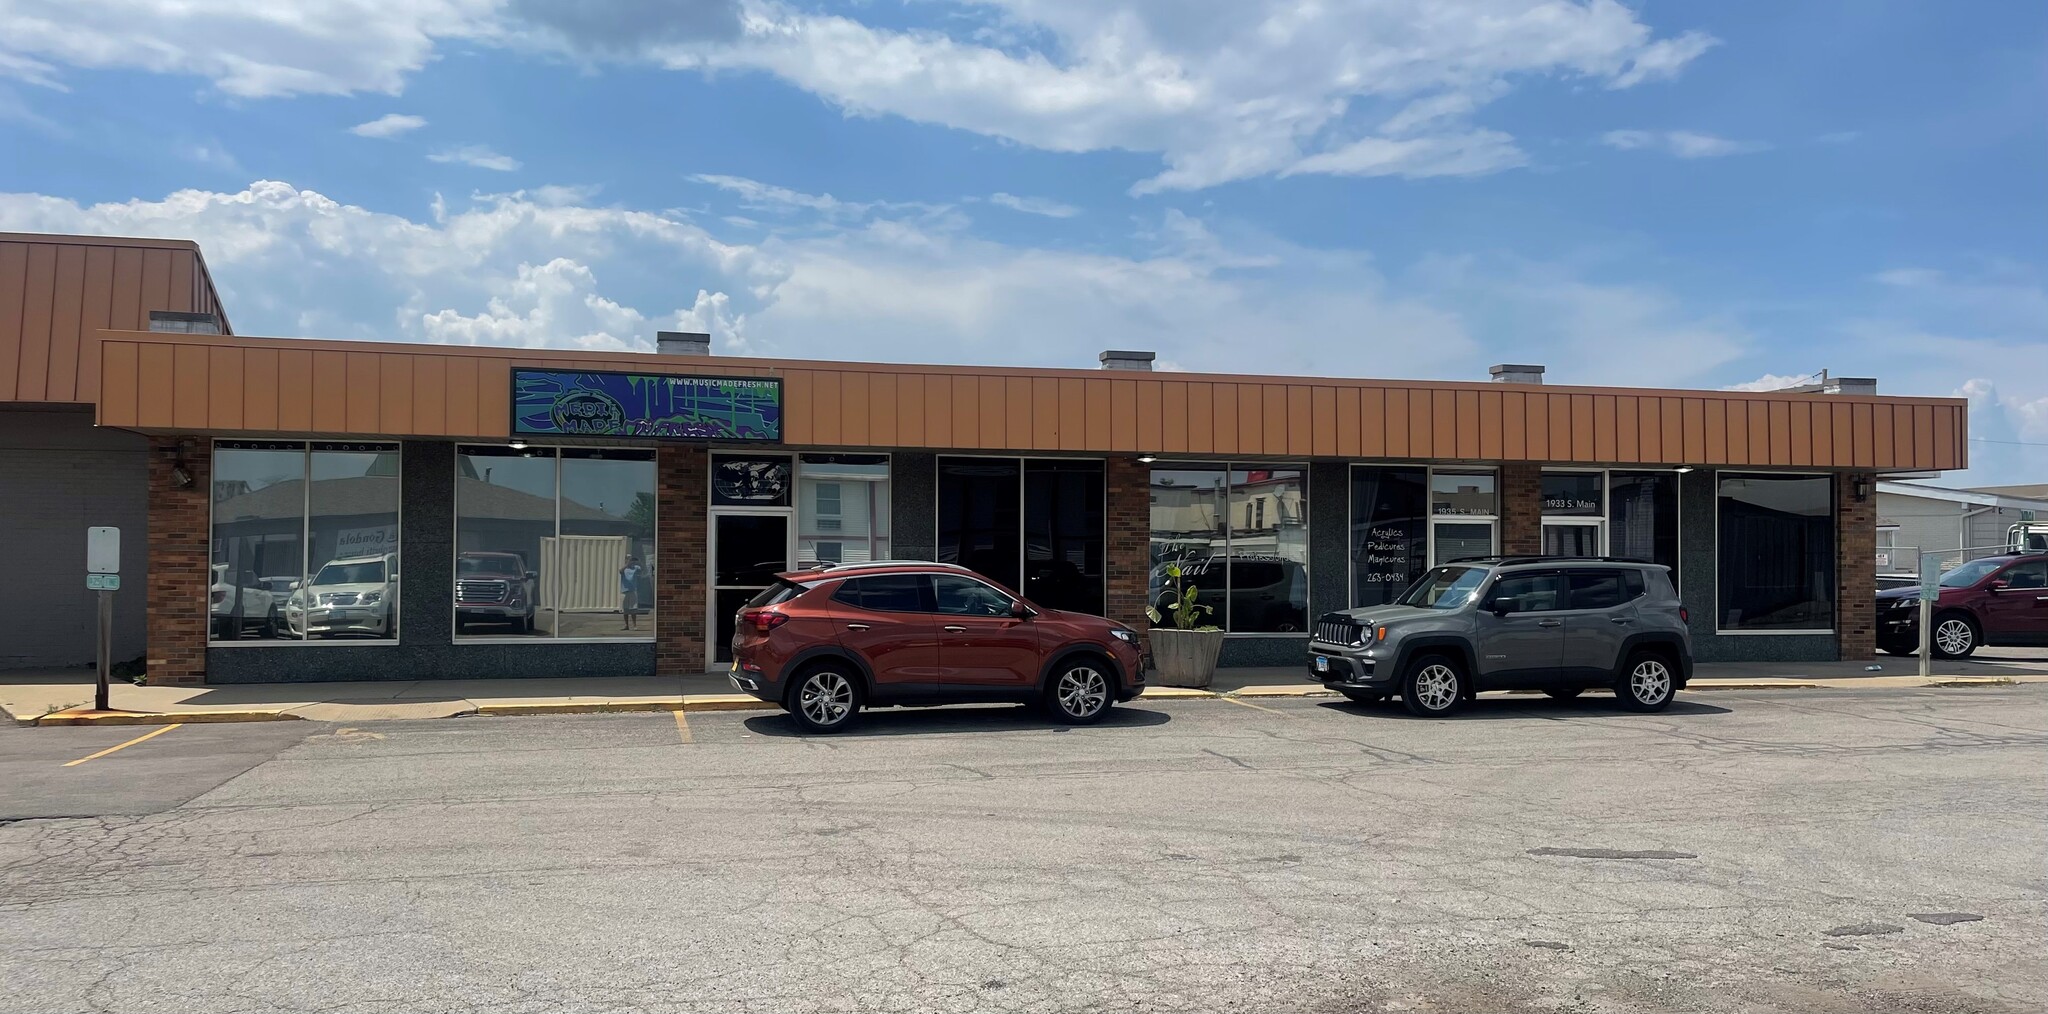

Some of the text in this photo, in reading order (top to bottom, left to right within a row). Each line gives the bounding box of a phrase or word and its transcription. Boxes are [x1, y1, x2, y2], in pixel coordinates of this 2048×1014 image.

[669, 378, 779, 389] WWW.MUSICMADEFRESH.NET
[562, 419, 621, 434] MADE
[1546, 499, 1596, 508] 1933 S. Main
[1371, 527, 1404, 539] Acrylics
[1367, 542, 1406, 551] Pedicures
[1155, 550, 1217, 578] Nail
[1367, 553, 1406, 566] Manicures
[1367, 572, 1404, 583] 263-0434
